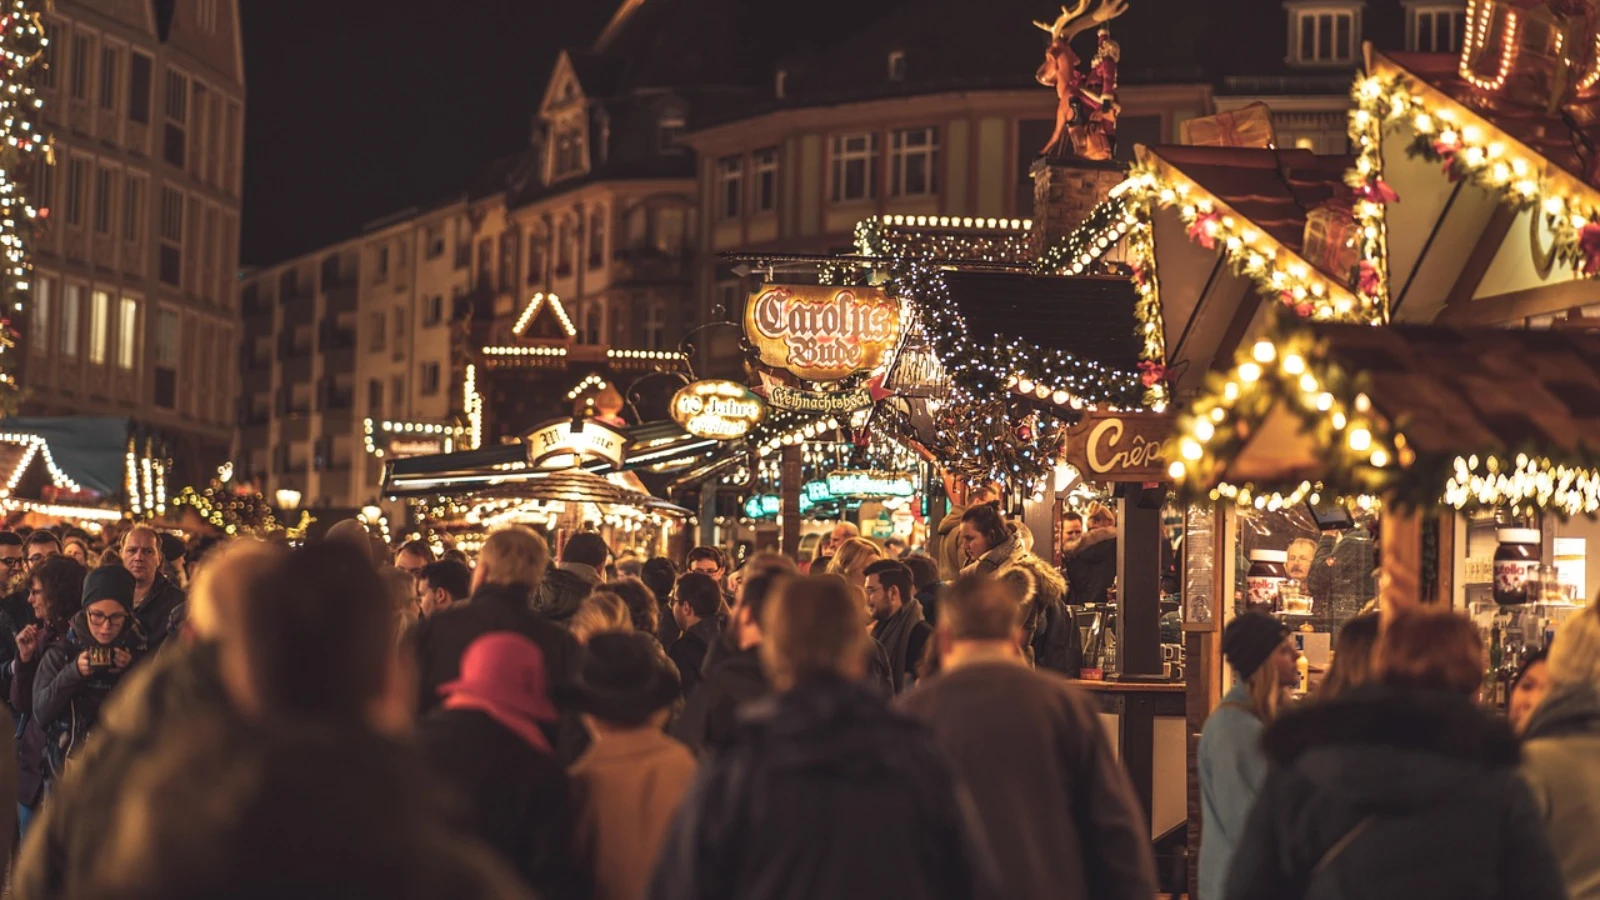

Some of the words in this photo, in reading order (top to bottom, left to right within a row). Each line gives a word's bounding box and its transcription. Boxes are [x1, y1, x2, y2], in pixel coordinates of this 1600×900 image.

[756, 288, 891, 341] Carolus
[787, 335, 861, 367] Bude
[705, 398, 758, 415] Jahre
